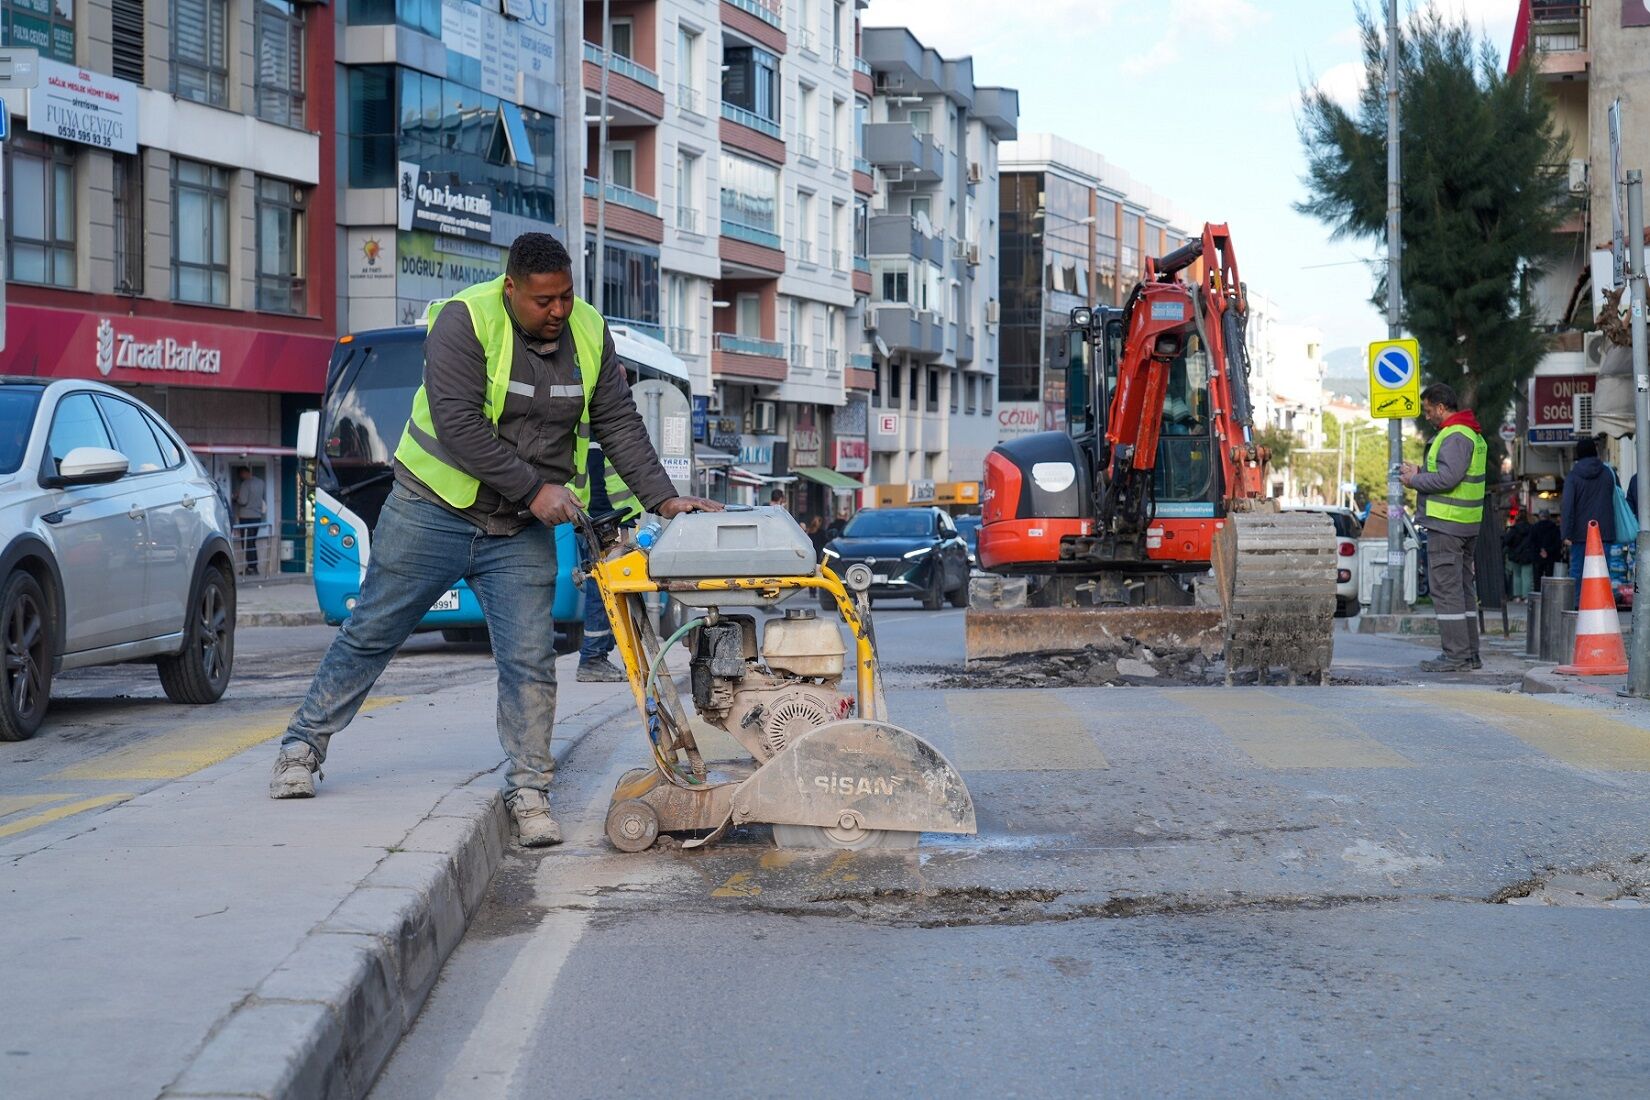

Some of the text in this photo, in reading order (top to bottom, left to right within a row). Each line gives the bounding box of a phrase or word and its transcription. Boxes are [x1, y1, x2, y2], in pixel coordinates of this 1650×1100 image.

[47, 104, 79, 129] FULYA
[58, 125, 76, 138] 0530
[103, 136, 112, 147] 35
[402, 256, 435, 277] DOĞRU
[437, 262, 470, 283] ZAMAN
[116, 333, 221, 373] Ziraat Bankası
[884, 418, 893, 429] E
